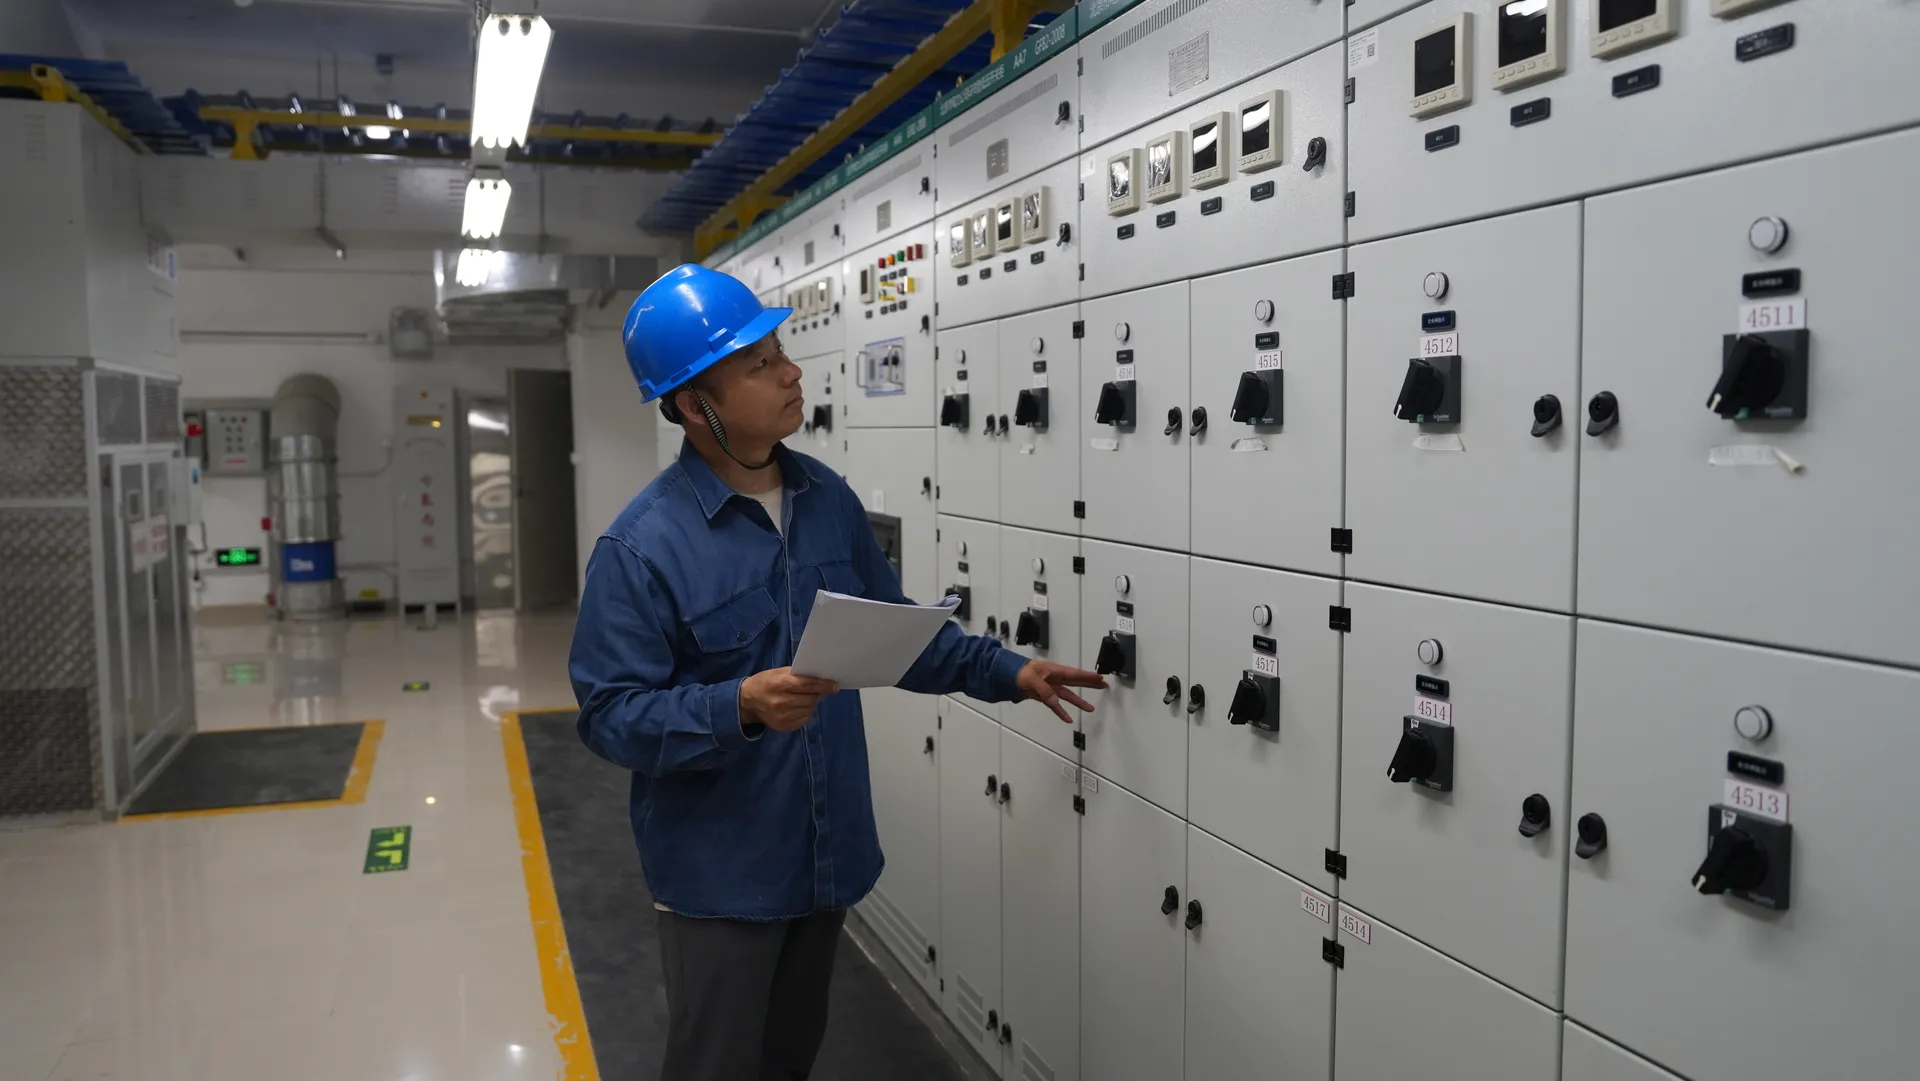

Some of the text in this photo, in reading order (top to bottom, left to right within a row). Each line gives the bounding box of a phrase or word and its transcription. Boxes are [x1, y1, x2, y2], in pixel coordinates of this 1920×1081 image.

[1013, 49, 1027, 70] AA7
[1746, 305, 1795, 328] 4511
[1425, 337, 1453, 355] 4512
[1258, 354, 1279, 369] 4515
[1118, 367, 1133, 380] 4516
[1255, 656, 1275, 673] 4517
[1418, 700, 1447, 721] 4514
[1731, 786, 1780, 815] 4513
[1303, 896, 1326, 917] 4517
[1342, 915, 1367, 939] 4514
